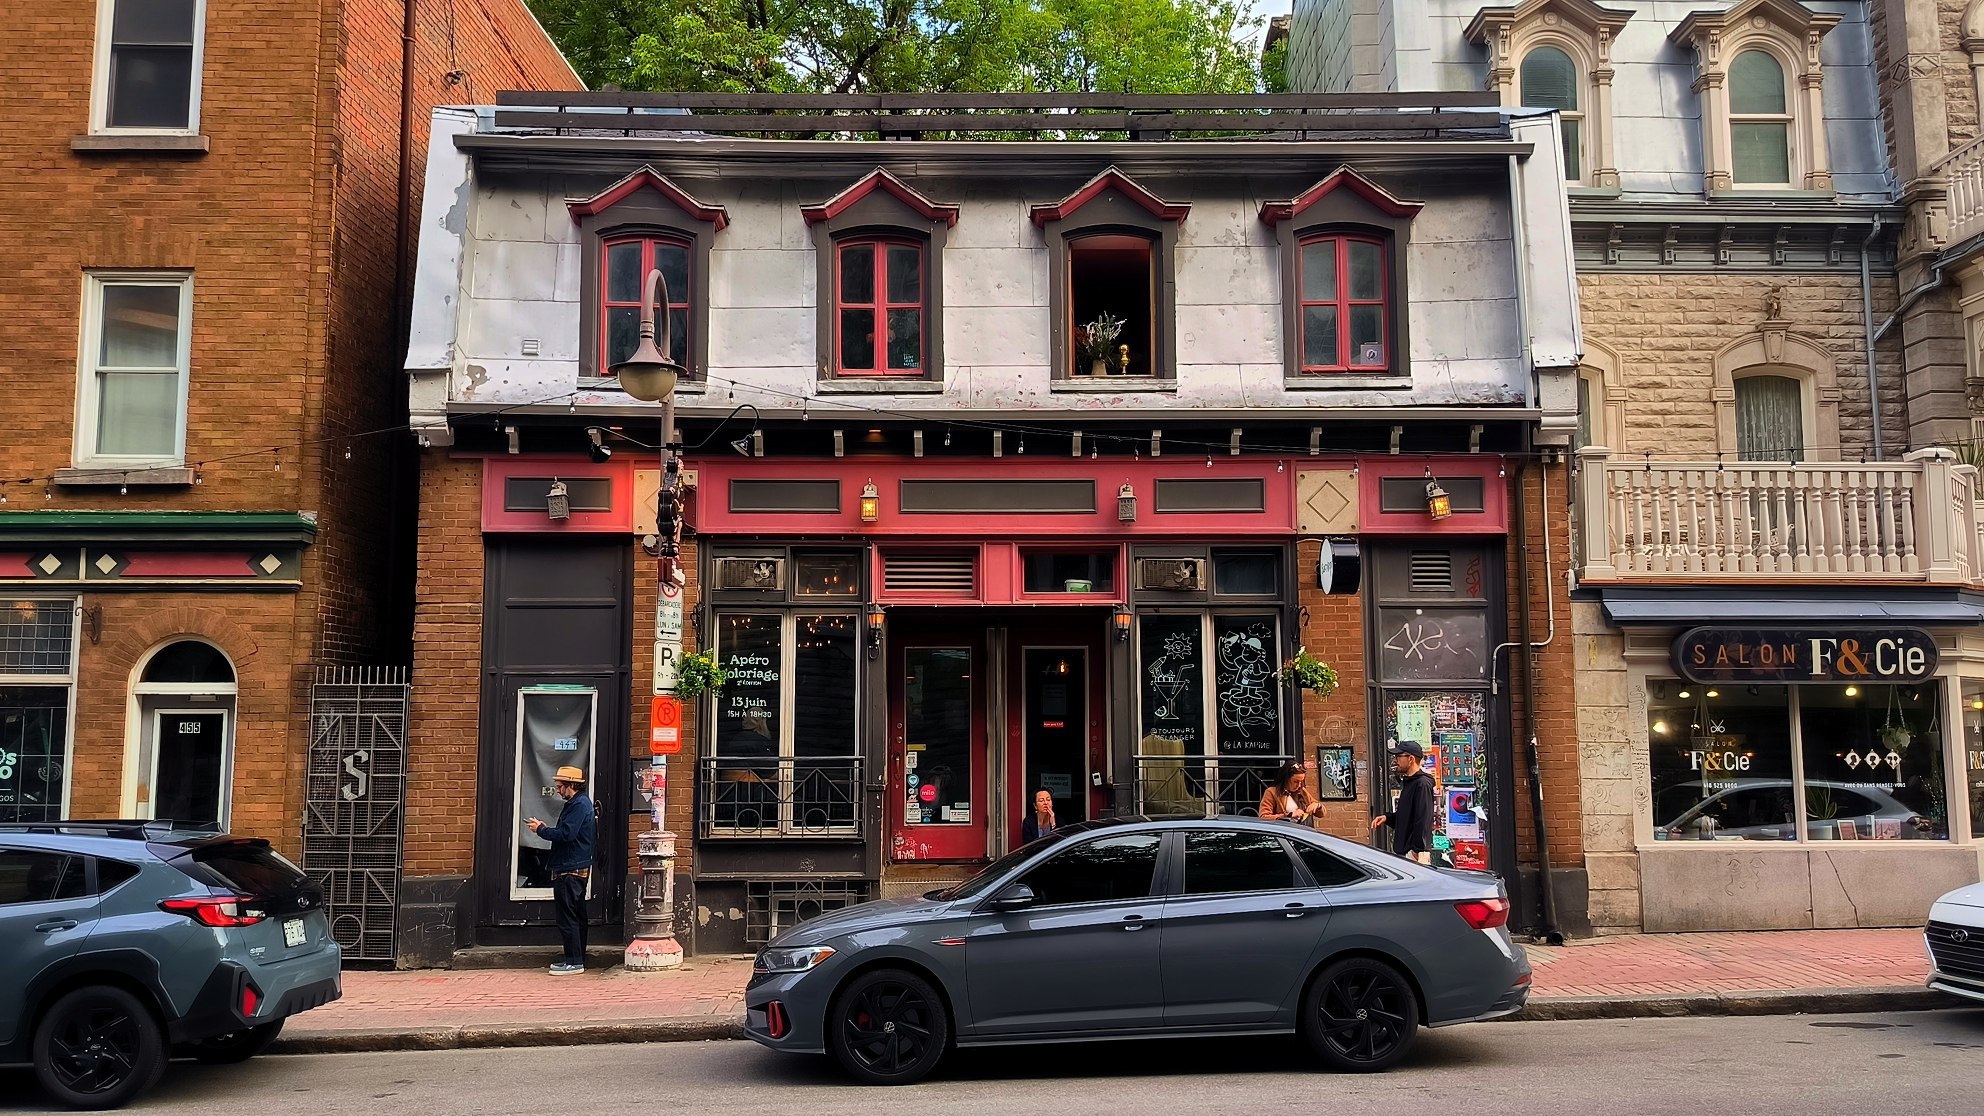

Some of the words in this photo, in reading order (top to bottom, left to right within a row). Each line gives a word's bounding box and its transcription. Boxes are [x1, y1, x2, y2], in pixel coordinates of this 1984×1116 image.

[730, 653, 770, 667] Apéro
[1694, 644, 1795, 664] SALON
[1807, 638, 1925, 676] F&Cie
[732, 697, 743, 707] 13
[744, 697, 767, 709] juin
[727, 710, 740, 718] 15H
[741, 709, 747, 718] À
[179, 722, 201, 733] 455
[1690, 751, 1750, 771] F&Cie
